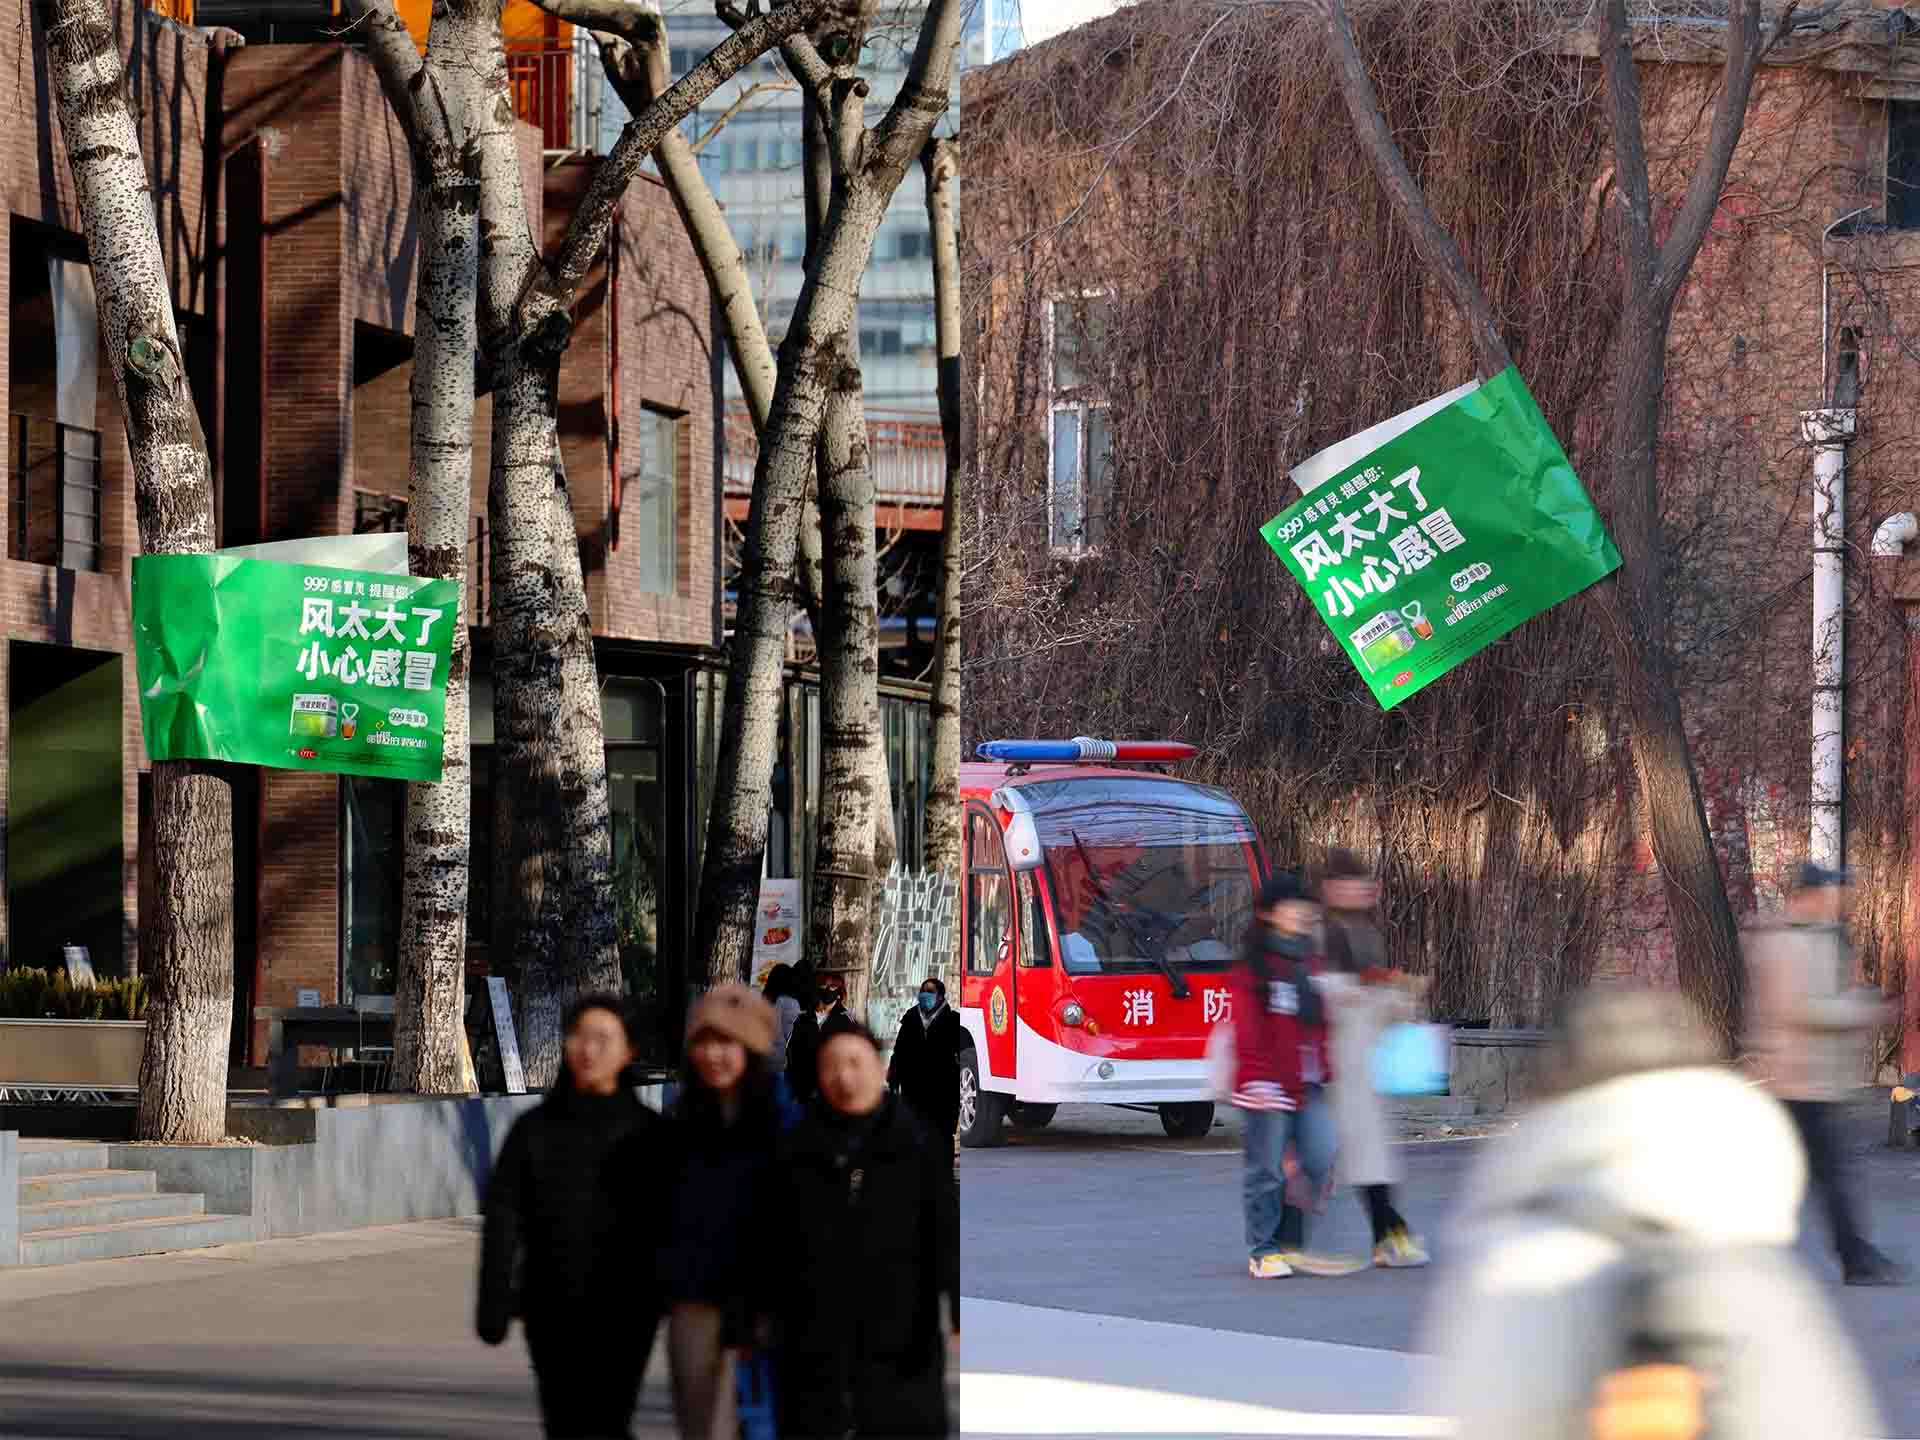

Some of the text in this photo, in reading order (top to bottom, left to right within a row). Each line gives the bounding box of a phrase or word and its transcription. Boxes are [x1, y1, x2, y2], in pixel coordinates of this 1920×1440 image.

[1289, 465, 1428, 581] 风太大了
[1323, 507, 1467, 617] 小心感冒
[299, 597, 443, 646] 风太大了
[296, 640, 437, 690] 小心感冒
